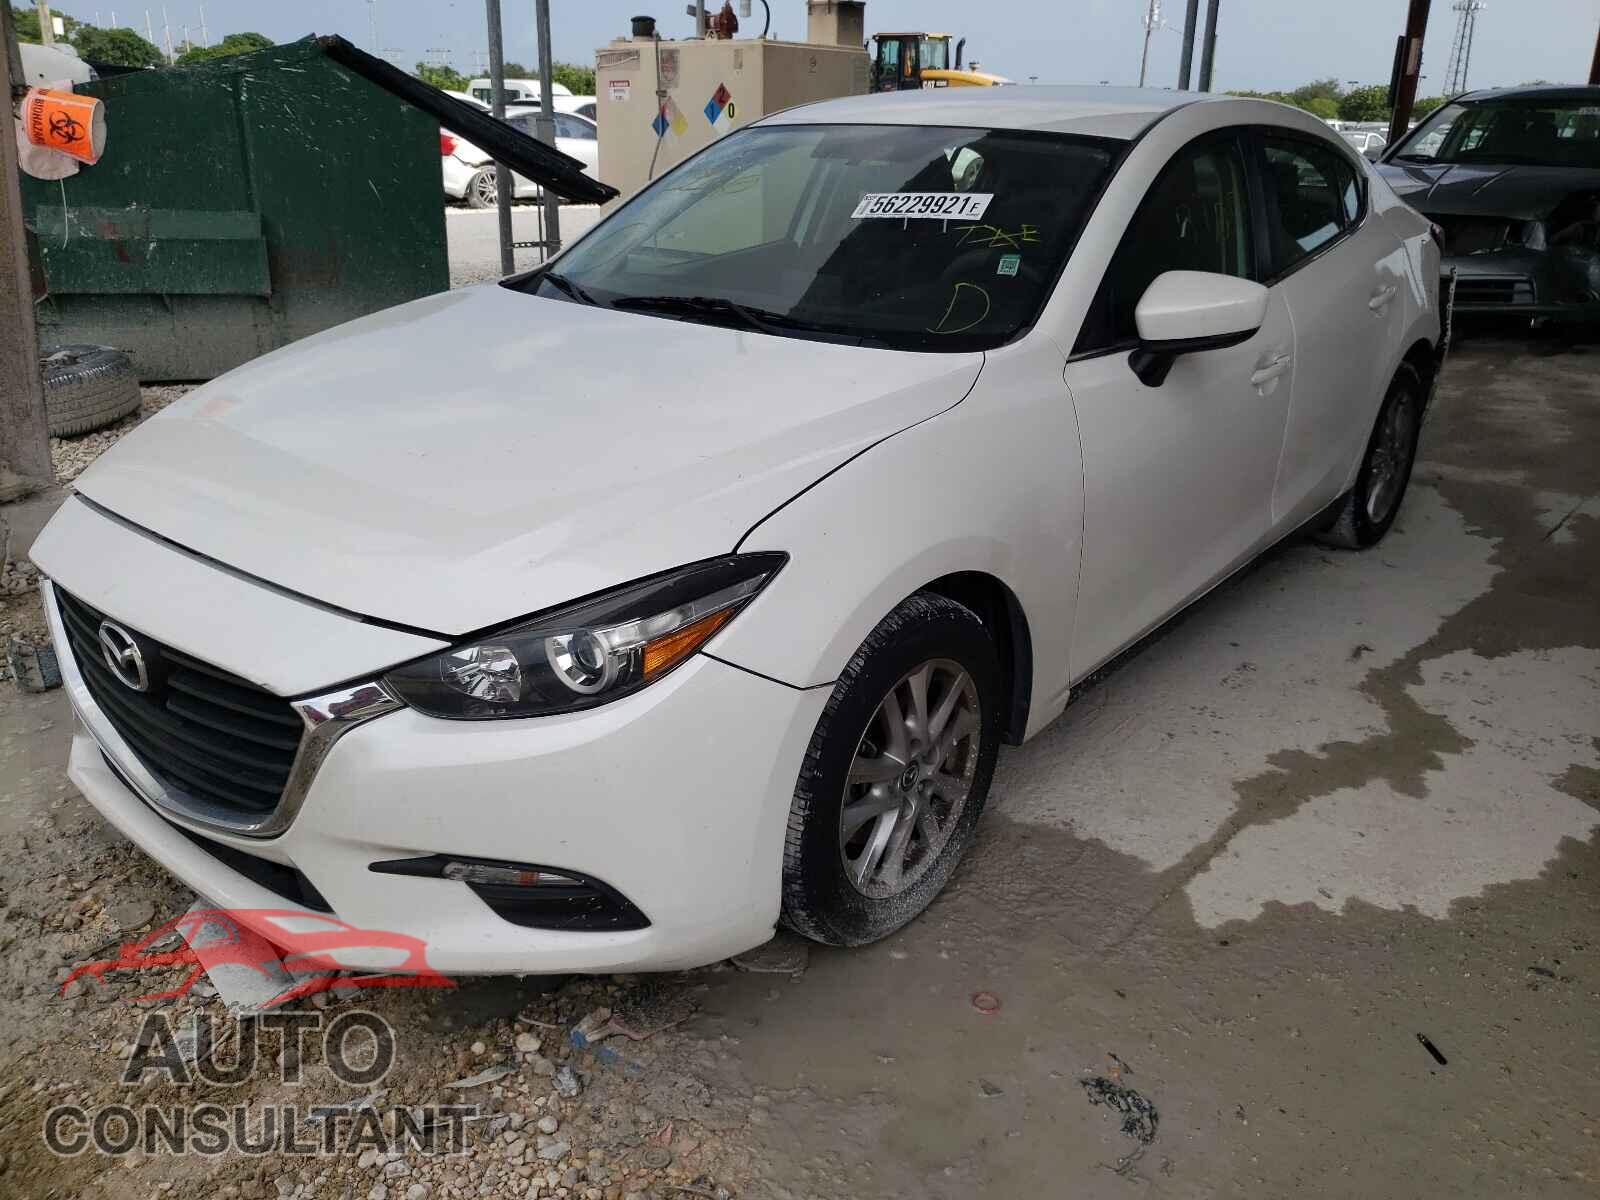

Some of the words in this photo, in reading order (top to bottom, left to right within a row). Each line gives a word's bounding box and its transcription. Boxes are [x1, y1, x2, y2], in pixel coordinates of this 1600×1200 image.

[728, 102, 735, 119] 0
[869, 195, 972, 214] 56229921
[969, 202, 981, 213] F
[926, 282, 990, 335] D
